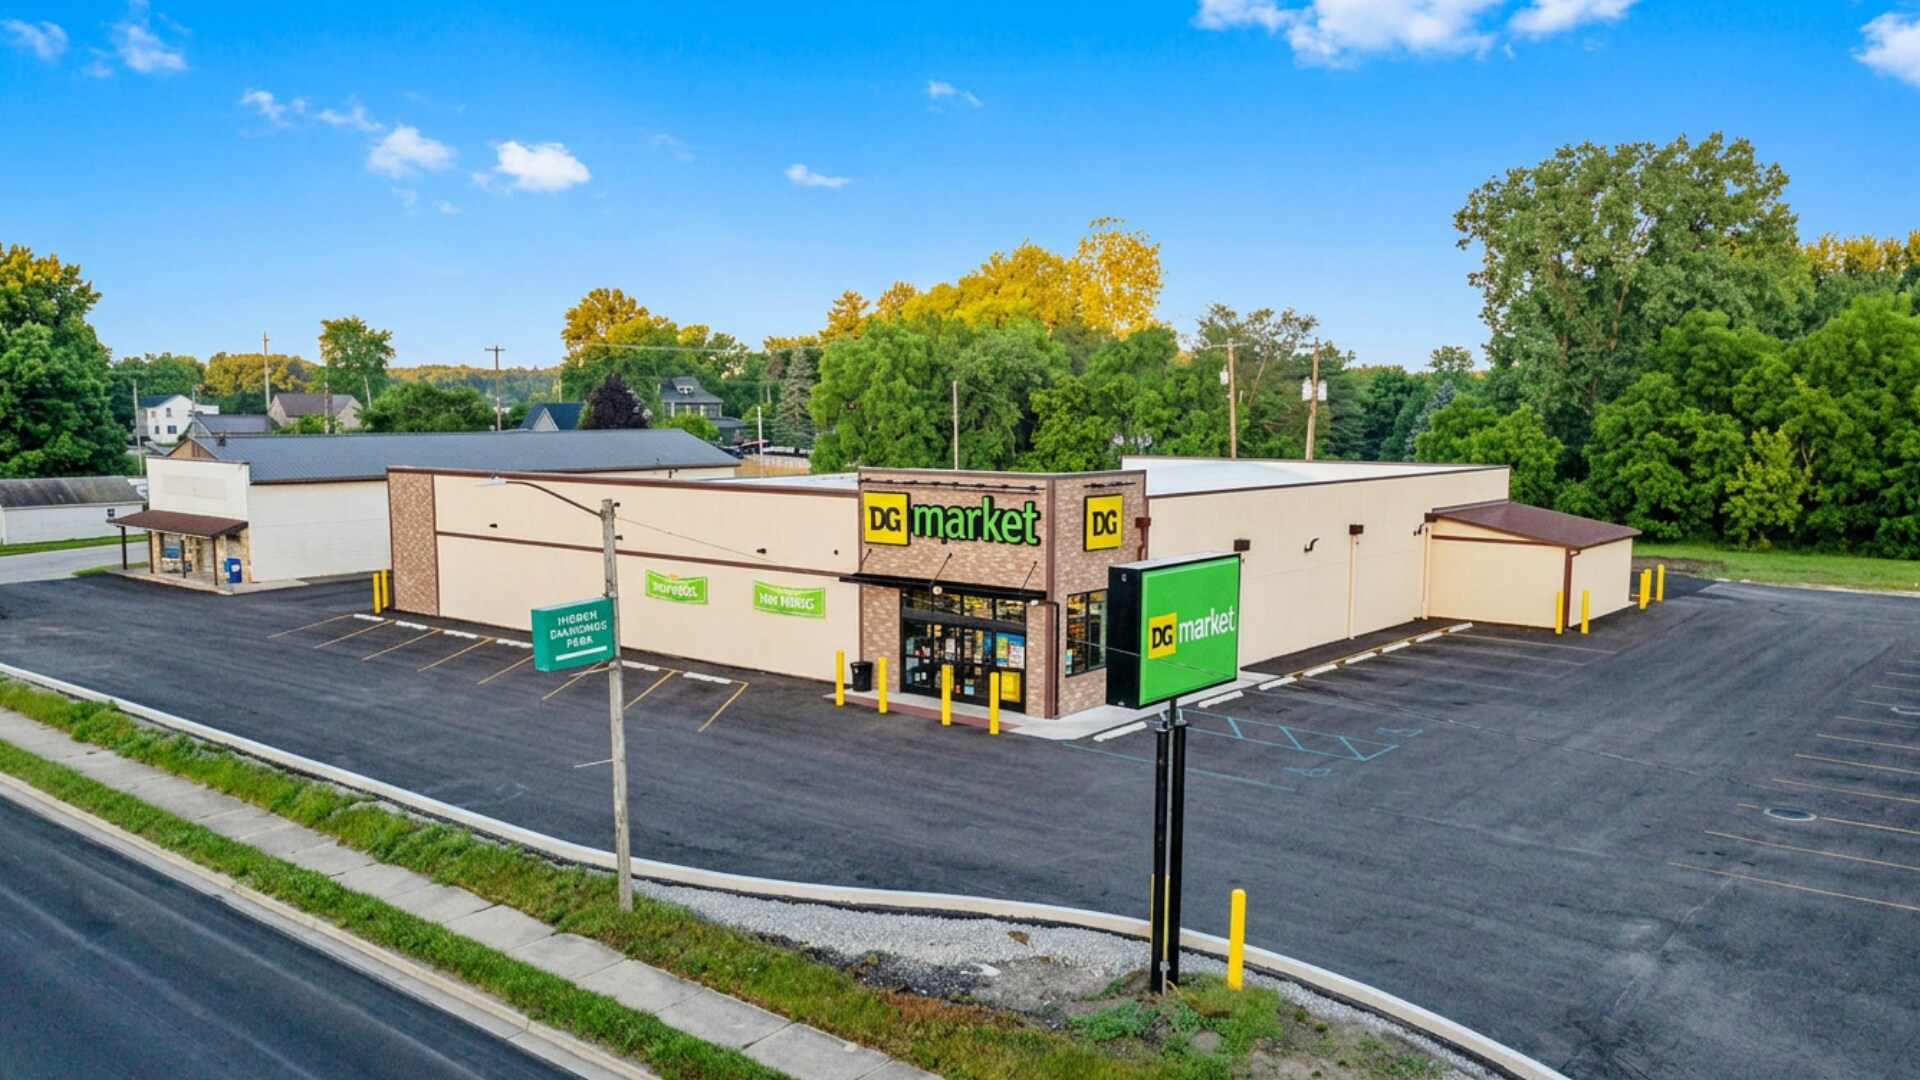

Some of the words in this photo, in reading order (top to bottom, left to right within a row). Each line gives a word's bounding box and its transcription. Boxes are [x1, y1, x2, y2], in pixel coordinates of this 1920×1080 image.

[869, 506, 902, 532] DG
[912, 496, 1040, 545] market
[1092, 509, 1118, 536] DG
[1151, 624, 1174, 649] DG
[1179, 605, 1236, 644] market
